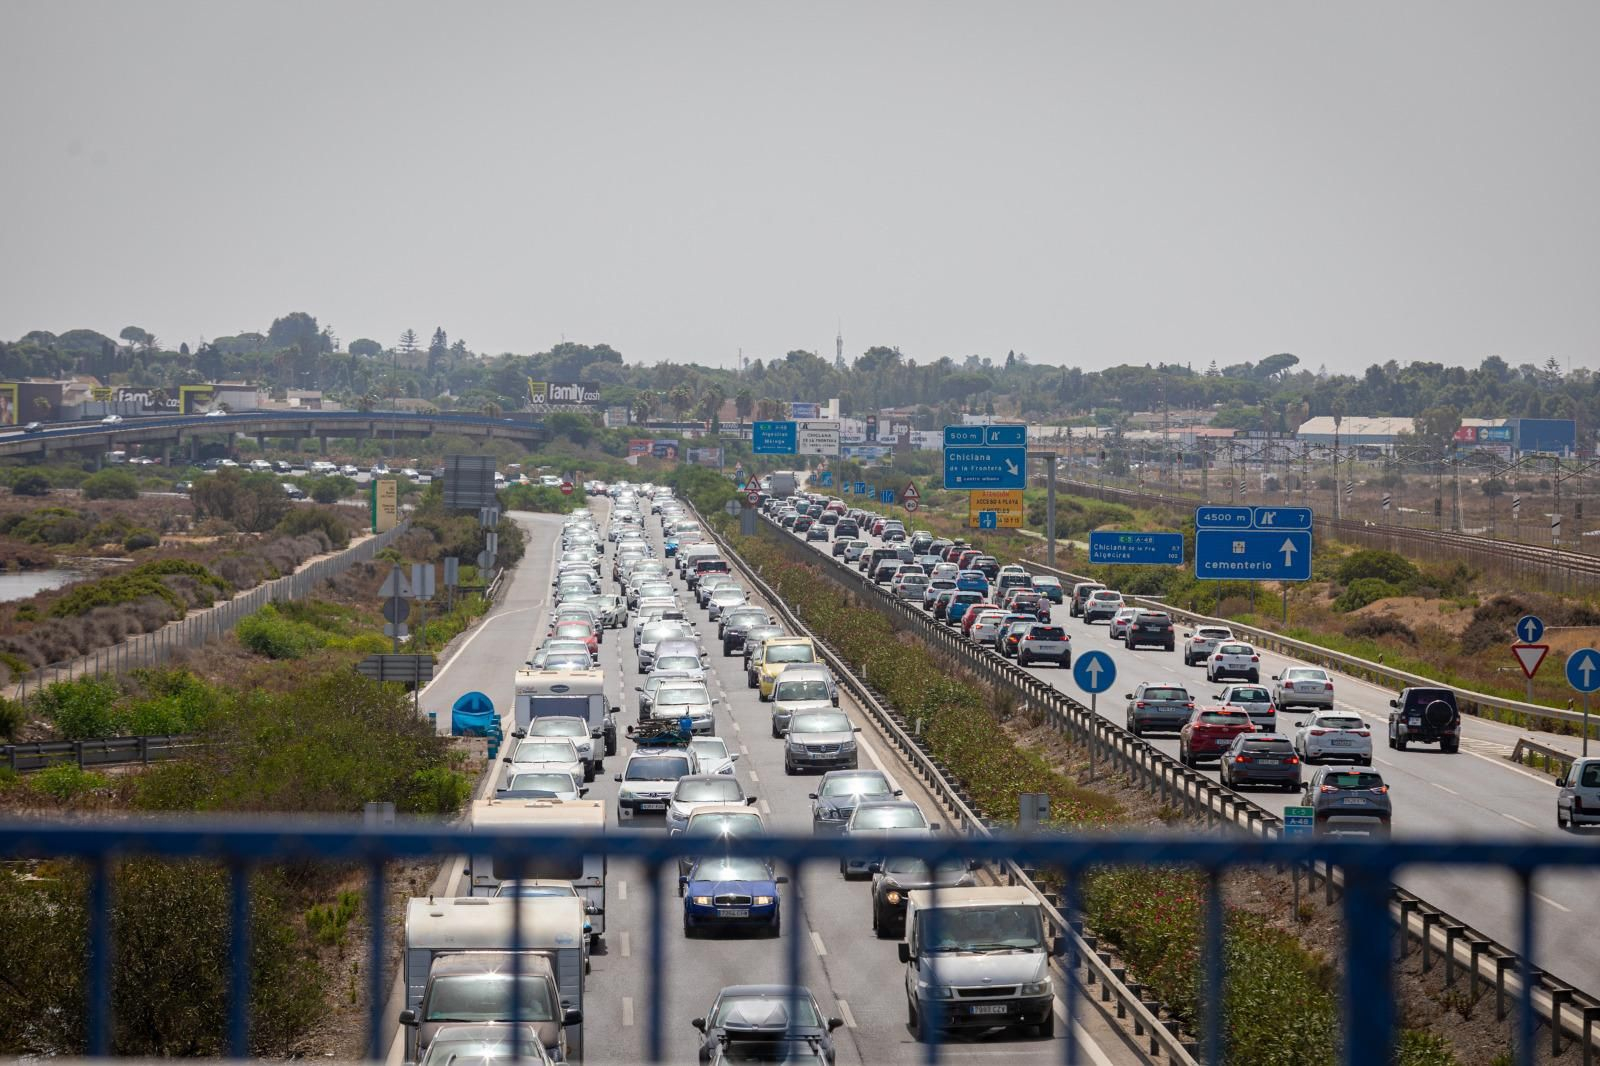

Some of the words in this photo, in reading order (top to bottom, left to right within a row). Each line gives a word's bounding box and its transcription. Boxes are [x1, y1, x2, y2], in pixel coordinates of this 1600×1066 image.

[550, 384, 584, 403] family
[584, 390, 600, 400] cash
[1205, 561, 1272, 570] cementerio
